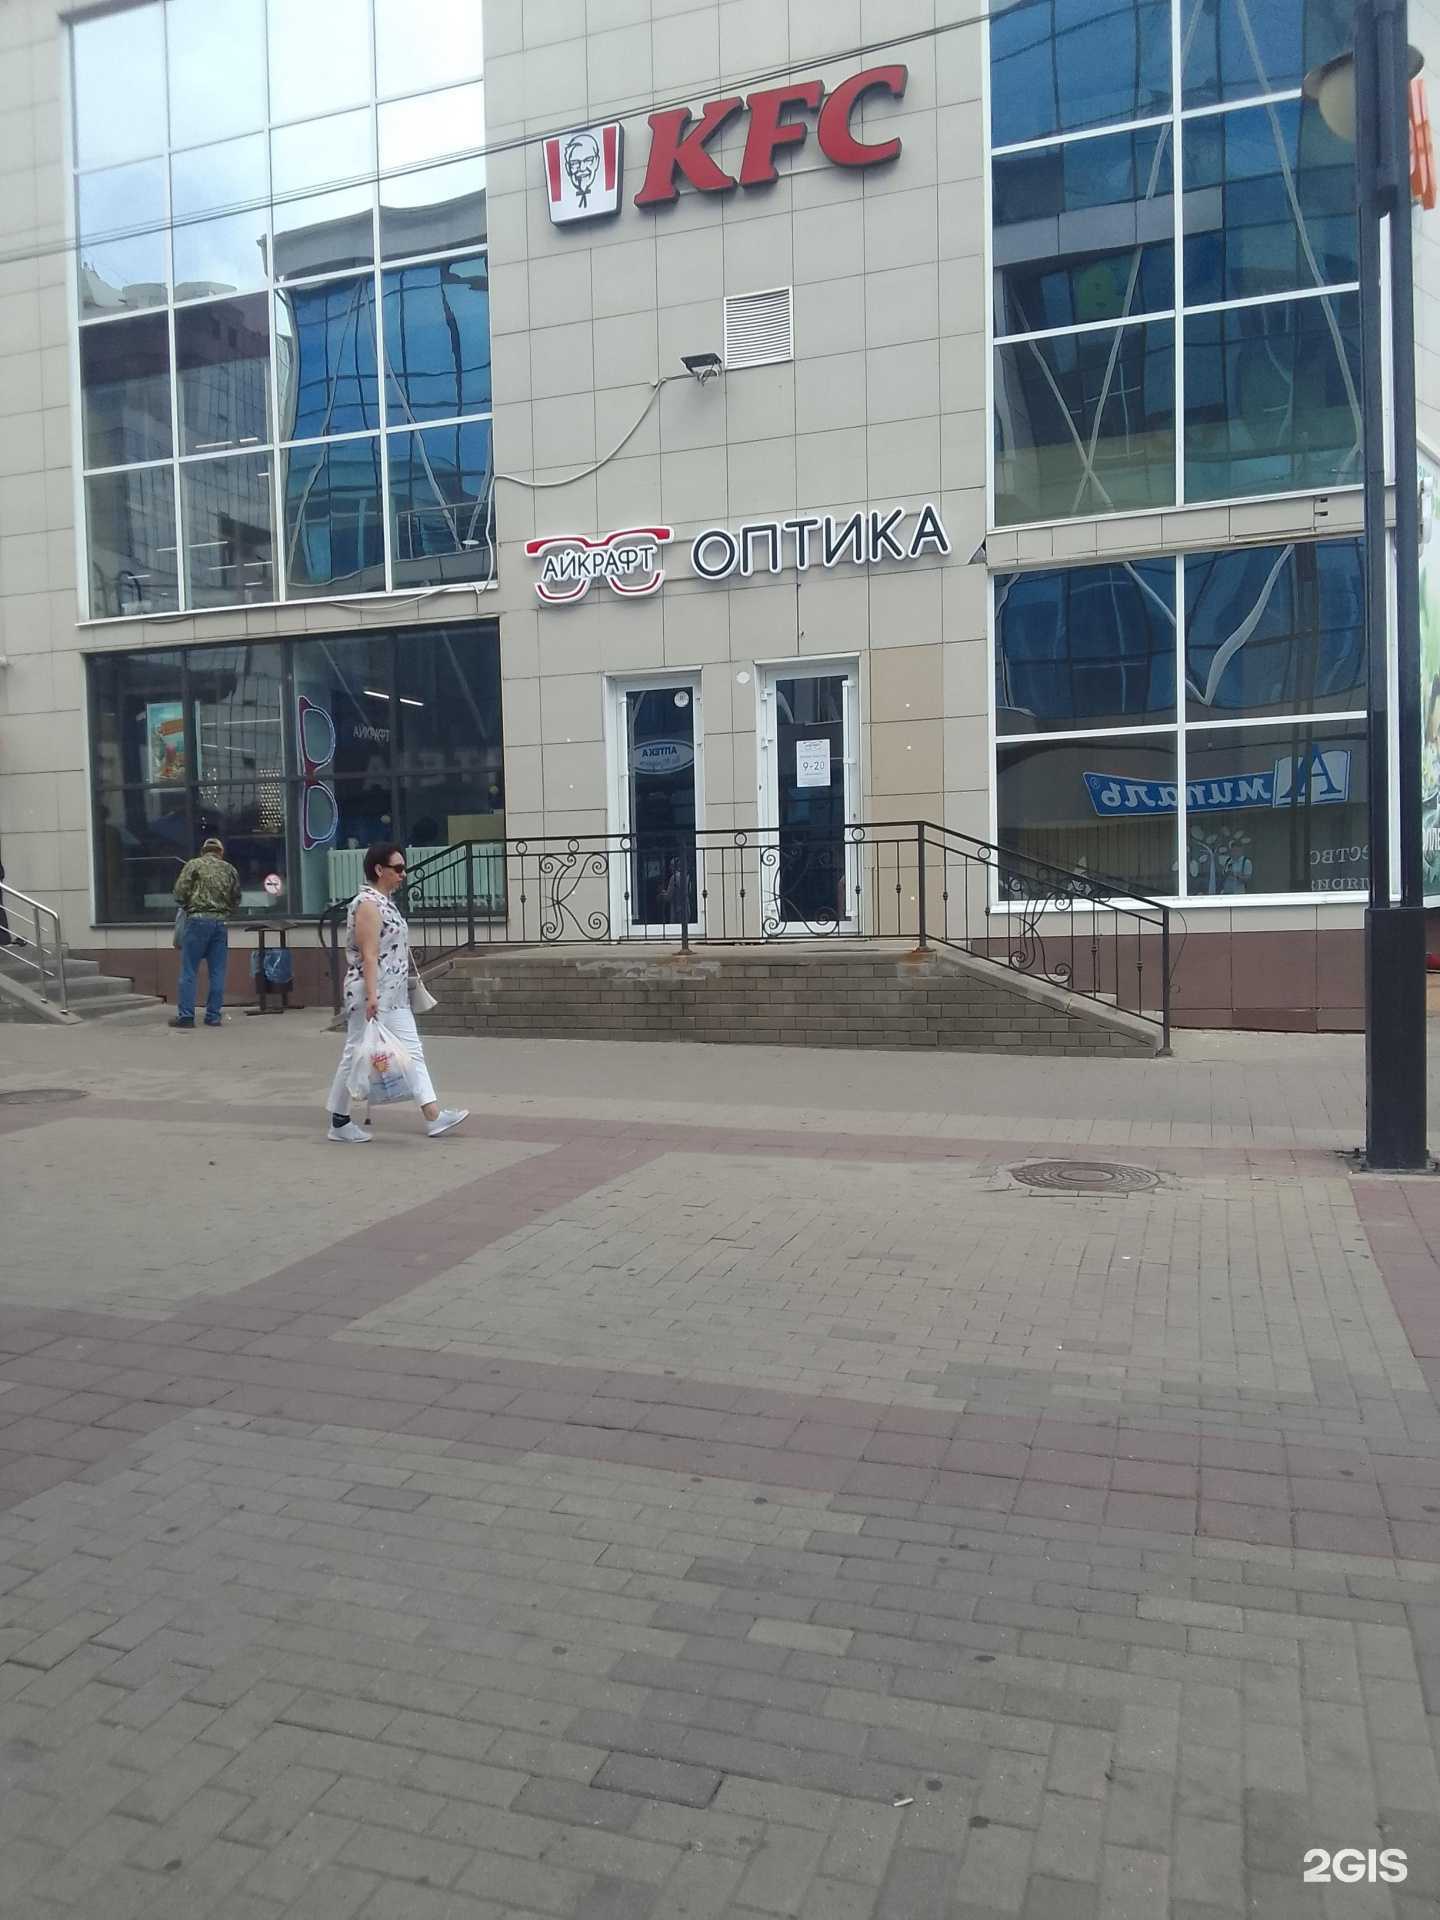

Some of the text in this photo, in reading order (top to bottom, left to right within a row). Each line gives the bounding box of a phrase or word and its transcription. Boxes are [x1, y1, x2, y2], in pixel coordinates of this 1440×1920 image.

[634, 64, 909, 208] KFC
[542, 504, 950, 582] АЙКРАФТ ОПТИКА
[802, 761, 825, 772] 9-20
